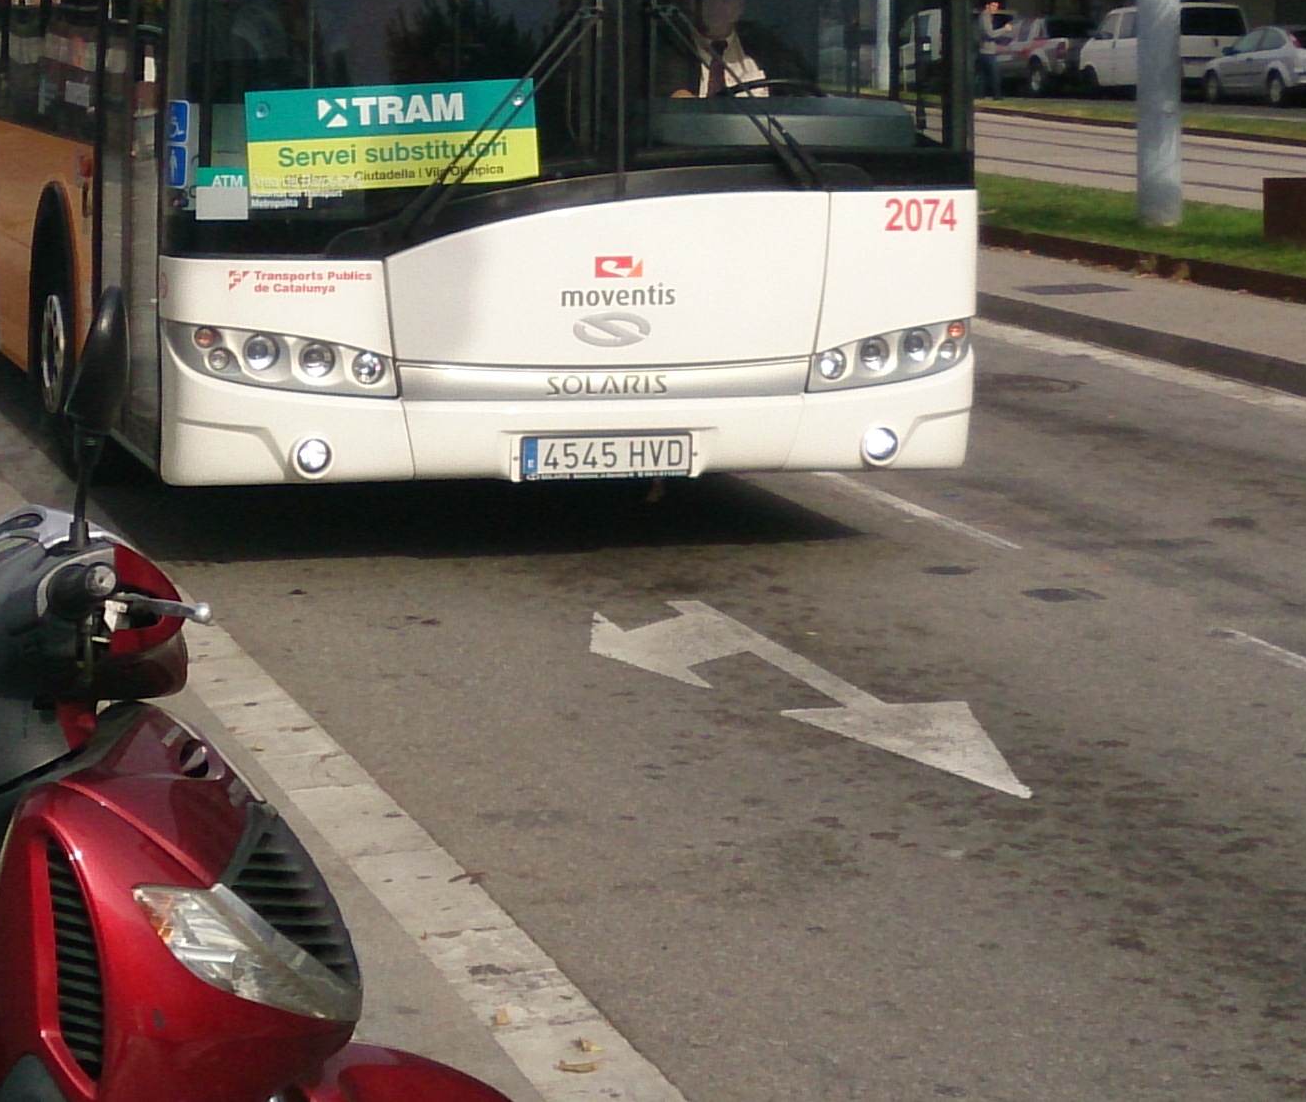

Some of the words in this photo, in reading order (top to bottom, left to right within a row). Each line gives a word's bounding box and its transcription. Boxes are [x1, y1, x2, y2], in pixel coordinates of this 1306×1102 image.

[352, 91, 464, 126] TRAM
[277, 143, 357, 168] Servei
[364, 135, 508, 165] substitutori
[211, 174, 244, 188] ATM
[884, 197, 958, 232] 2074
[253, 270, 324, 283] Transports
[253, 282, 270, 293] de
[272, 282, 336, 295] Catalunya
[560, 282, 677, 308] moventis
[545, 375, 668, 396] SOLARIS
[543, 441, 618, 470] 4545
[629, 439, 684, 467] HVD
